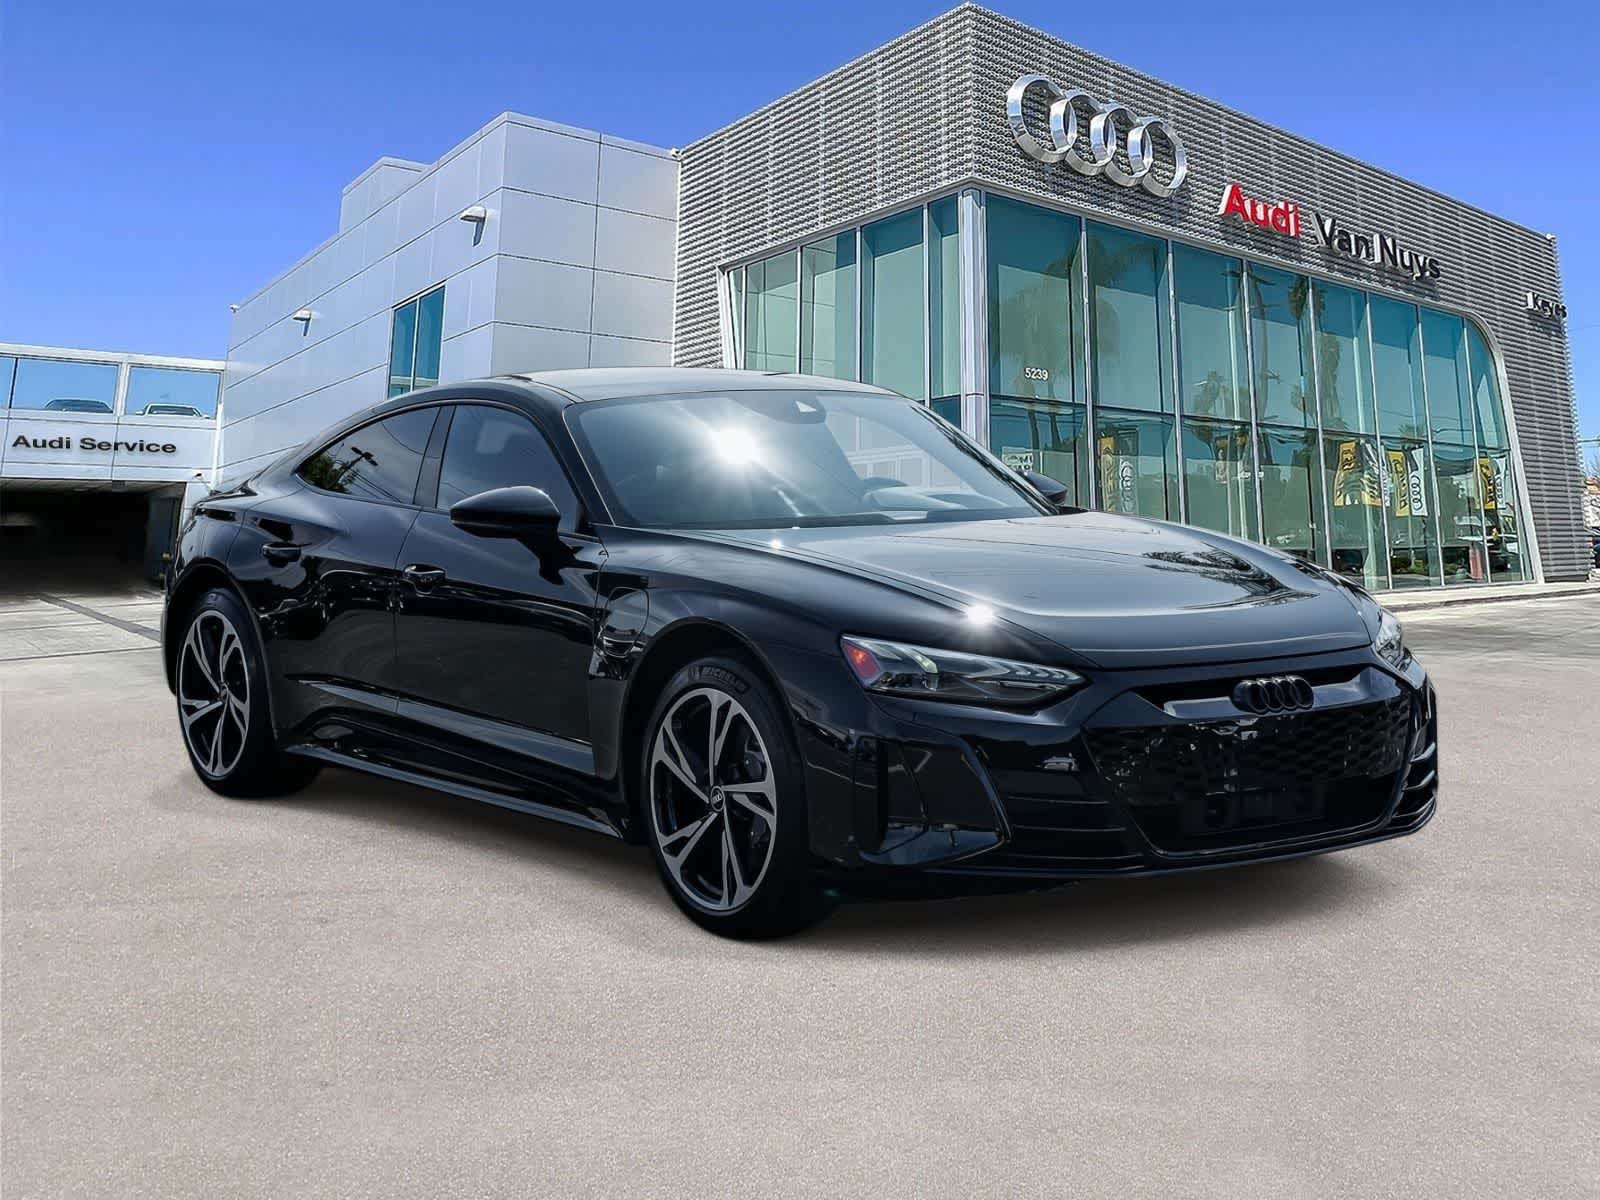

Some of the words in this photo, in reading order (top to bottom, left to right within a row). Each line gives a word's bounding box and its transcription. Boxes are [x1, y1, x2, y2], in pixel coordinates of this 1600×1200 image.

[1217, 182, 1301, 237] Audi
[1312, 212, 1370, 259] Van
[1373, 232, 1442, 281] Nuys
[1024, 367, 1049, 381] 5239
[12, 434, 72, 449] Audi
[79, 437, 178, 454] Service
